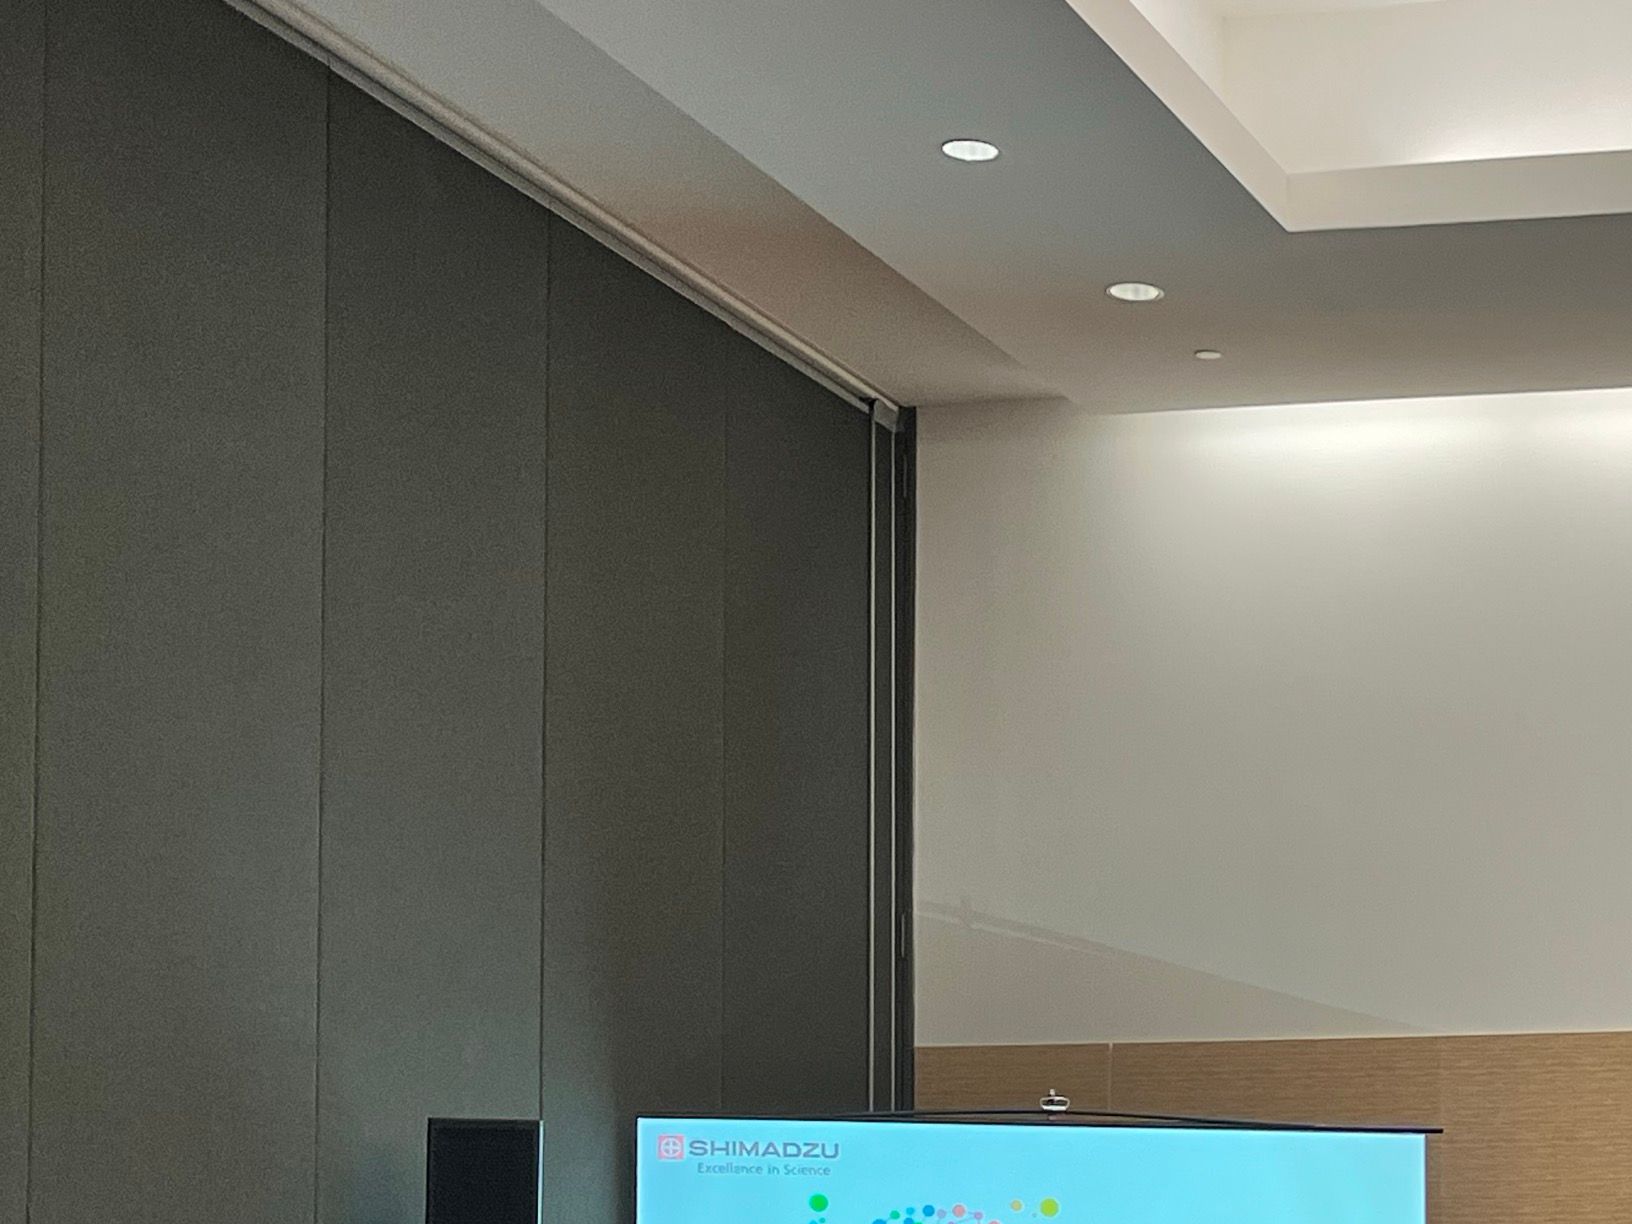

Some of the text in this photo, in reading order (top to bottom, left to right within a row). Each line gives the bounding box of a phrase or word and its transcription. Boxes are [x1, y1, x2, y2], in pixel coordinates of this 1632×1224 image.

[689, 1139, 840, 1159] SHIMADZU
[697, 1162, 832, 1176] Excellence in Science
